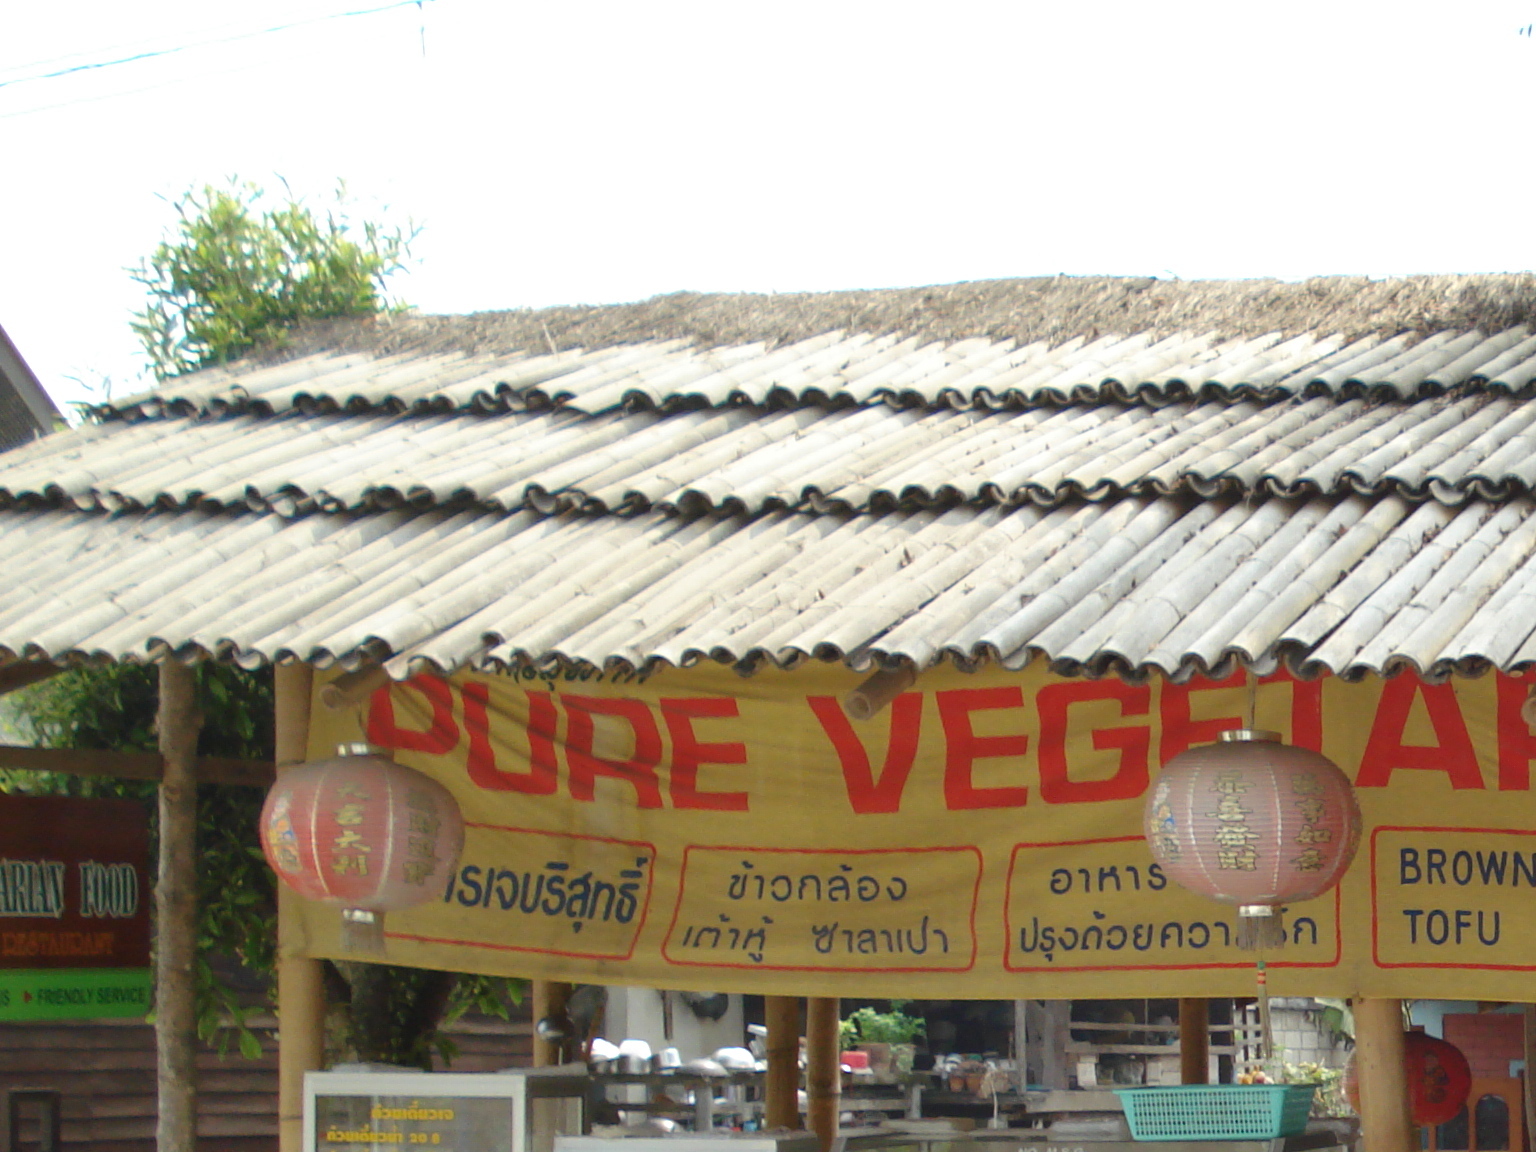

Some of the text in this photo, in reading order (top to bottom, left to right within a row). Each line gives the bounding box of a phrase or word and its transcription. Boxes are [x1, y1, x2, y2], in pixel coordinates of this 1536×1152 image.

[367, 673, 748, 812] PURE
[78, 859, 139, 918] FOOD
[728, 861, 908, 902] ข้าวกล้อง
[682, 914, 949, 962] เต้าหู้ ซาลาเปา
[1403, 909, 1501, 947] TOFU
[37, 986, 146, 1005] FRIENDLY SERVICE
[410, 1132, 428, 1144] 20
